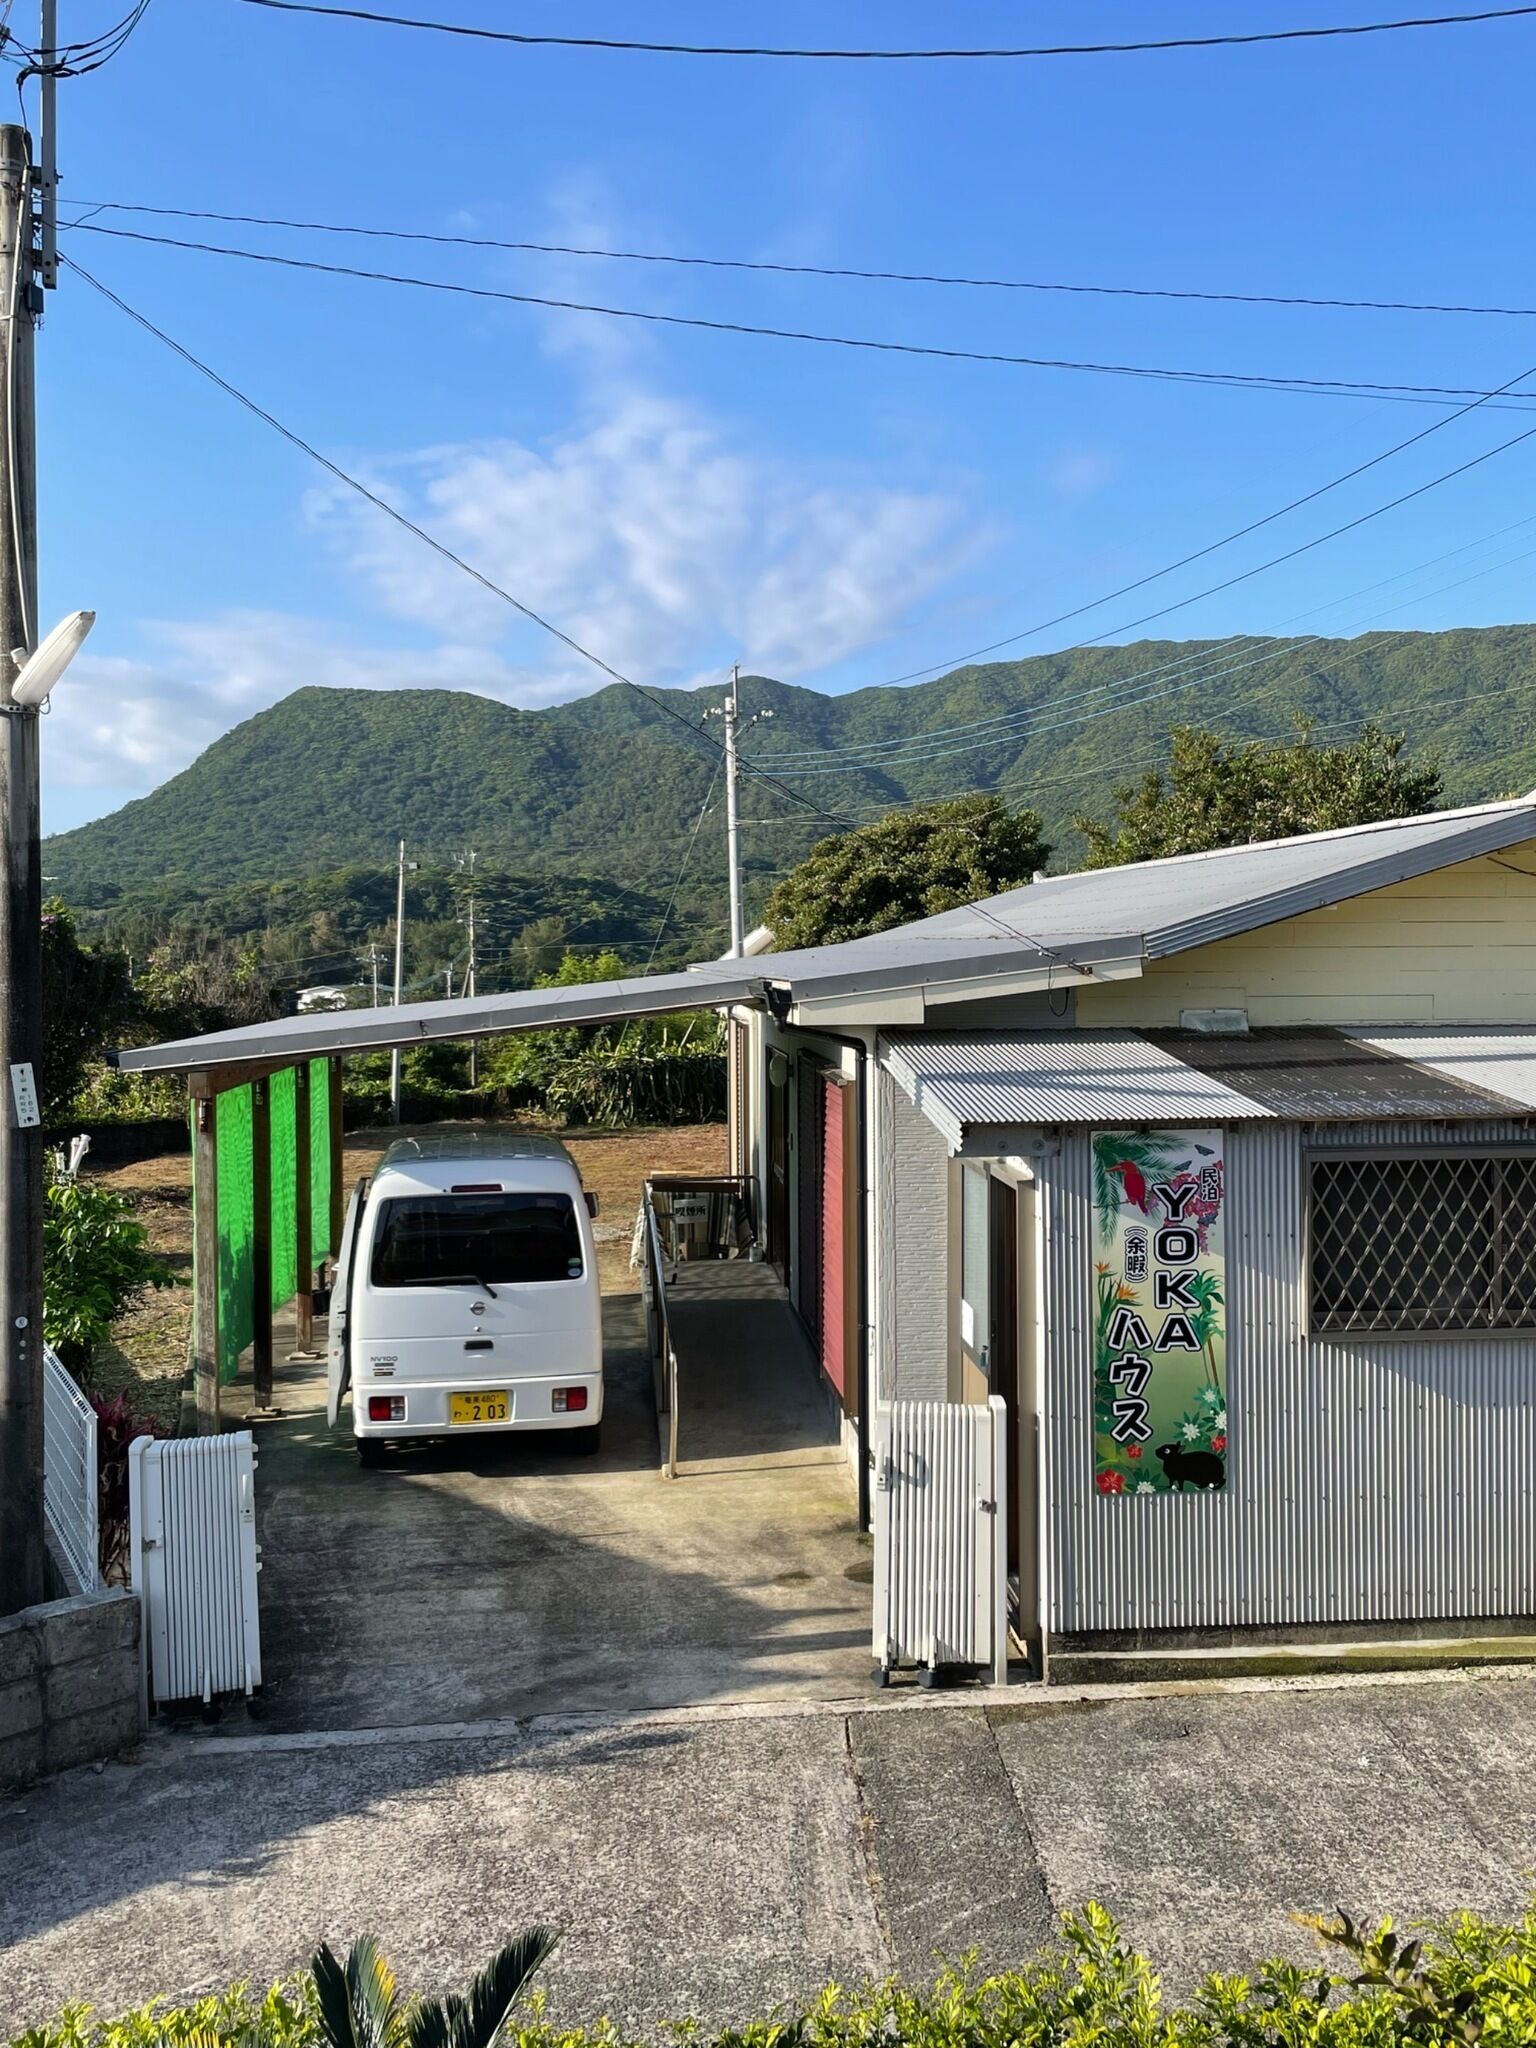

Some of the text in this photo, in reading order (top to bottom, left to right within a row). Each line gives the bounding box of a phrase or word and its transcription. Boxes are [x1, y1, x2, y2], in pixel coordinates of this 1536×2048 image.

[1201, 1166, 1218, 1201] 民泊
[1153, 1182, 1201, 1352] YOKA
[1109, 1308, 1152, 1442] ハウス
